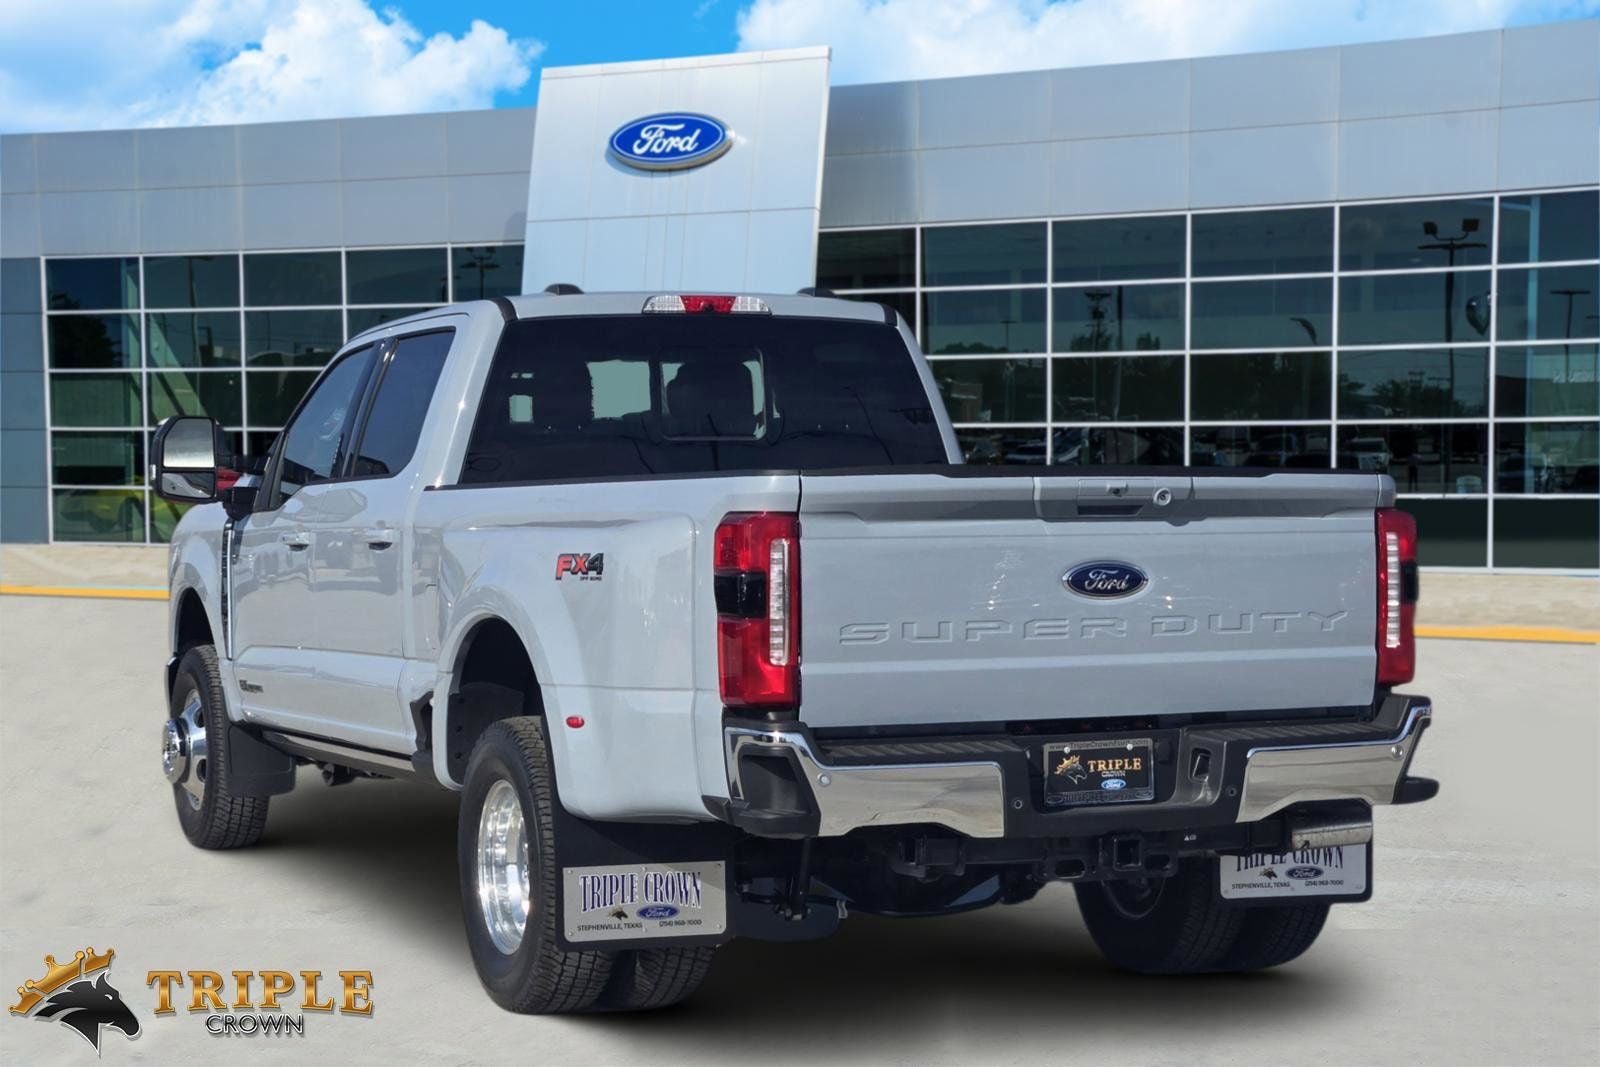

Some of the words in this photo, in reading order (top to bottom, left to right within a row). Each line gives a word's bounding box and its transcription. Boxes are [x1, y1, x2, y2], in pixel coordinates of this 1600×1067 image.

[632, 123, 701, 155] Ford
[555, 553, 604, 580] FX4
[1084, 568, 1130, 590] Ford
[839, 617, 1127, 645] SUPER
[1151, 611, 1348, 638] DUTY
[1087, 758, 1142, 773] TRIPLE
[1292, 867, 1316, 878] Ford
[580, 873, 638, 912] TRIPLE
[644, 871, 702, 909] CROWN
[645, 907, 670, 917] Ford
[576, 923, 623, 931] STEPHENVILLE,
